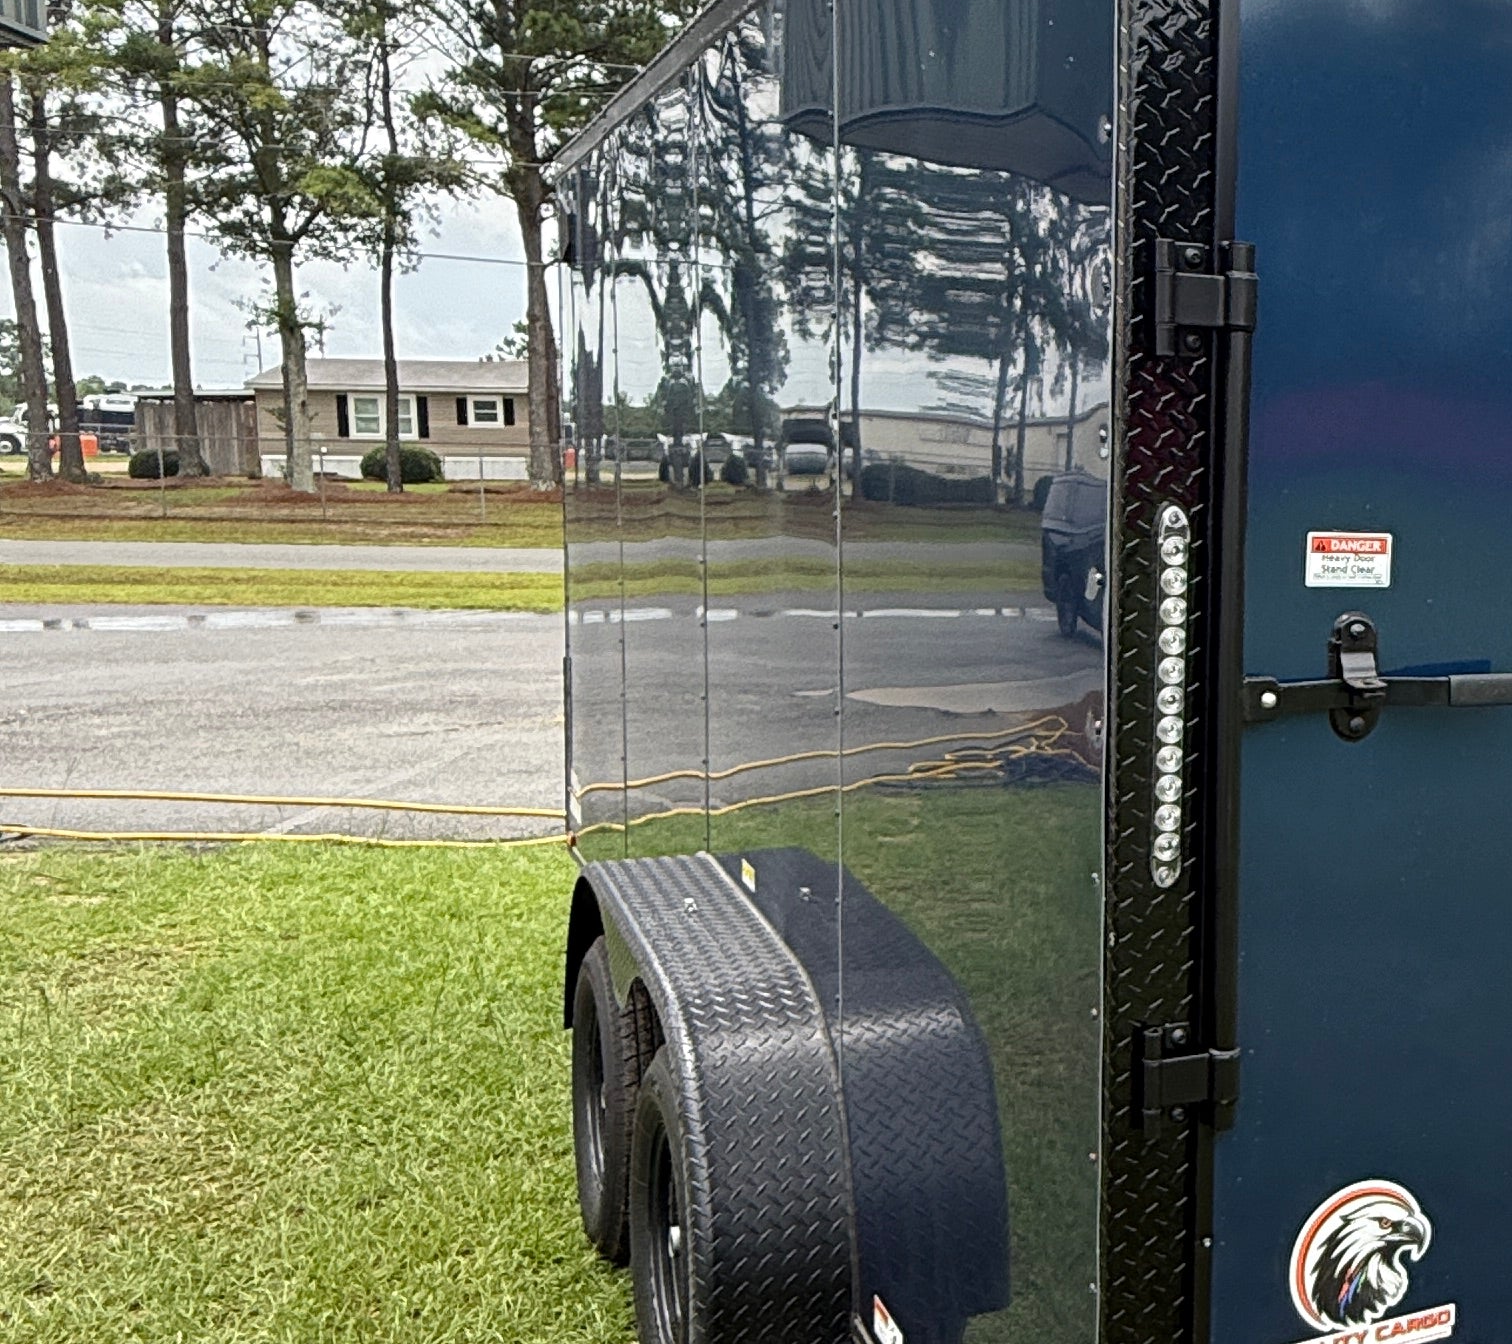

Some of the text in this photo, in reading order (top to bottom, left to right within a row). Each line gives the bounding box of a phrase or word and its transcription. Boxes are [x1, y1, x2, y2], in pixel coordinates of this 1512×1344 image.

[1331, 539, 1381, 552] DANGER
[1321, 553, 1375, 565] Heavy Door
[1321, 564, 1375, 574] Stand Clear
[1375, 1309, 1452, 1341] CARGO
